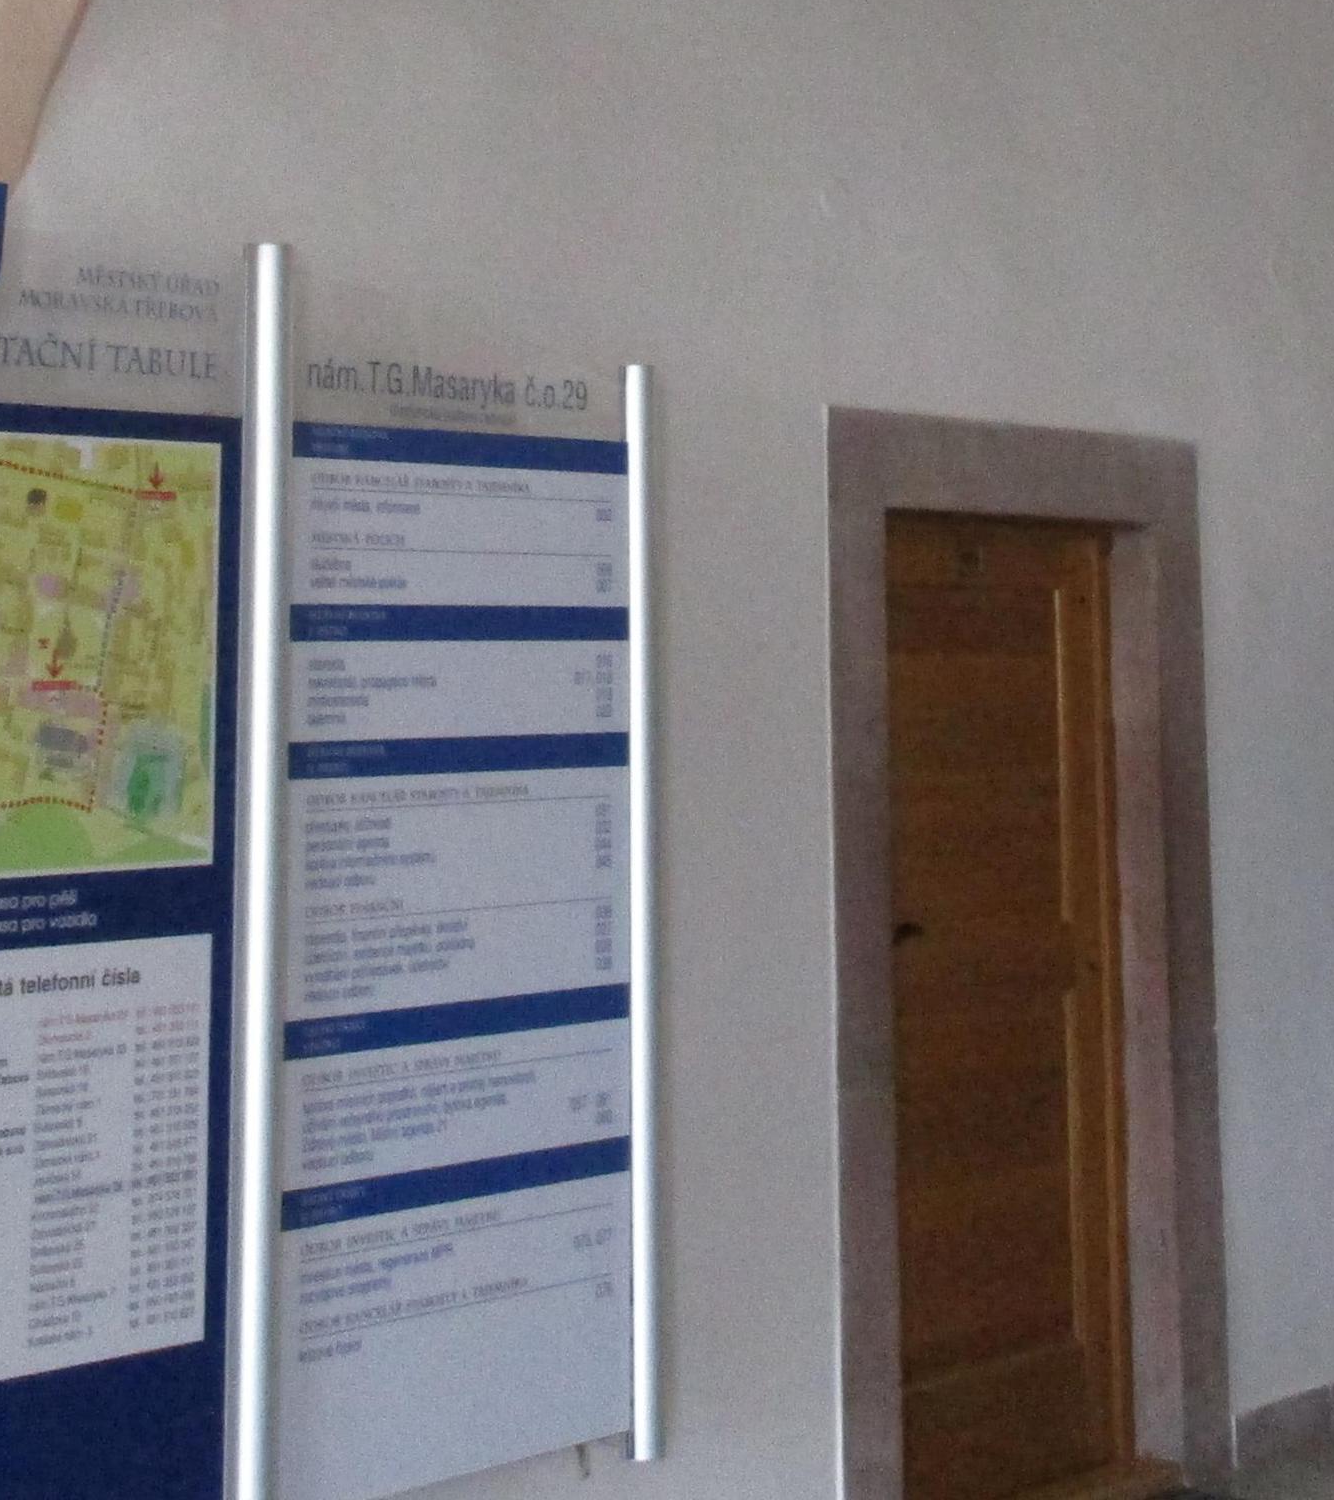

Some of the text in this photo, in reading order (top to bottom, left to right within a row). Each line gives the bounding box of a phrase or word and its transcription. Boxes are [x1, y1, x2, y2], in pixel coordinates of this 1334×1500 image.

[107, 342, 219, 380] TABULE
[524, 375, 589, 412] č.o.29
[20, 969, 97, 996] telefonní
[101, 964, 142, 989] čísla
